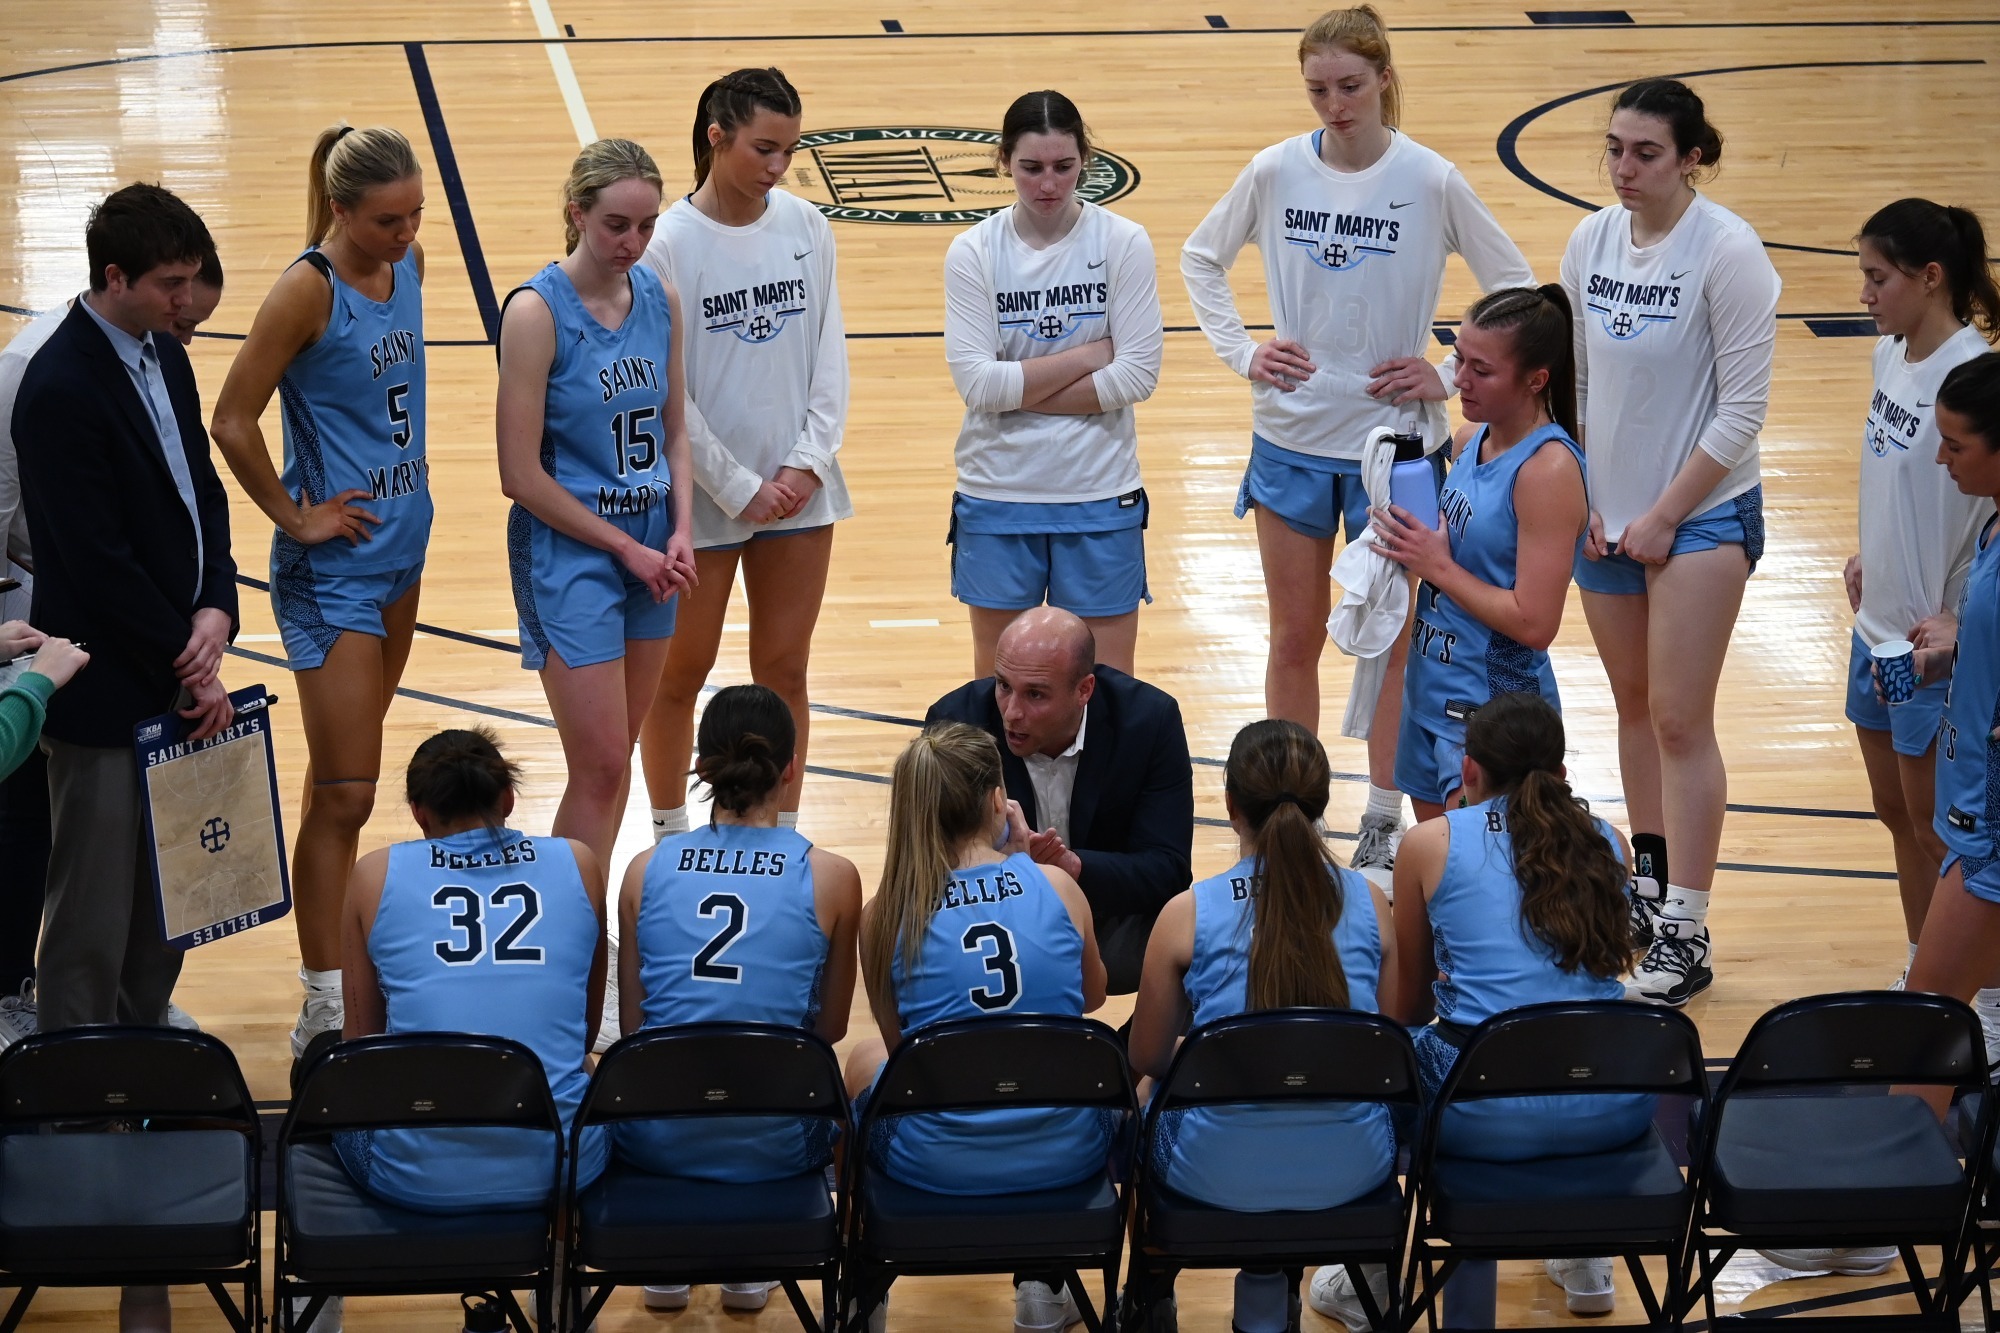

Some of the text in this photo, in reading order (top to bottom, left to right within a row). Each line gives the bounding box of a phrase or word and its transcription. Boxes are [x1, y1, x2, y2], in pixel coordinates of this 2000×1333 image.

[879, 129, 1002, 143] MICHI
[1284, 208, 1400, 242] SAINT MARY'S
[1289, 230, 1391, 248] BASKETBALL
[702, 279, 806, 319] SAINT MARY'S
[711, 300, 803, 326] BASKETBALL
[996, 282, 1107, 313] SAINT MARY'S
[1624, 283, 1681, 307] MARY'S
[369, 329, 416, 382] SAINT
[598, 356, 659, 404] SAINT
[386, 381, 413, 451] 5
[1882, 399, 1921, 438] MARY'S
[610, 405, 658, 478] 15
[1410, 616, 1458, 666] RY'S
[147, 718, 260, 766] SAINT MARY'S
[429, 839, 537, 871] BELLES
[676, 847, 788, 878] BELLES
[192, 911, 261, 946] BELLES
[431, 881, 546, 967] 32
[691, 891, 749, 985] 2
[960, 920, 1023, 1014] 3
